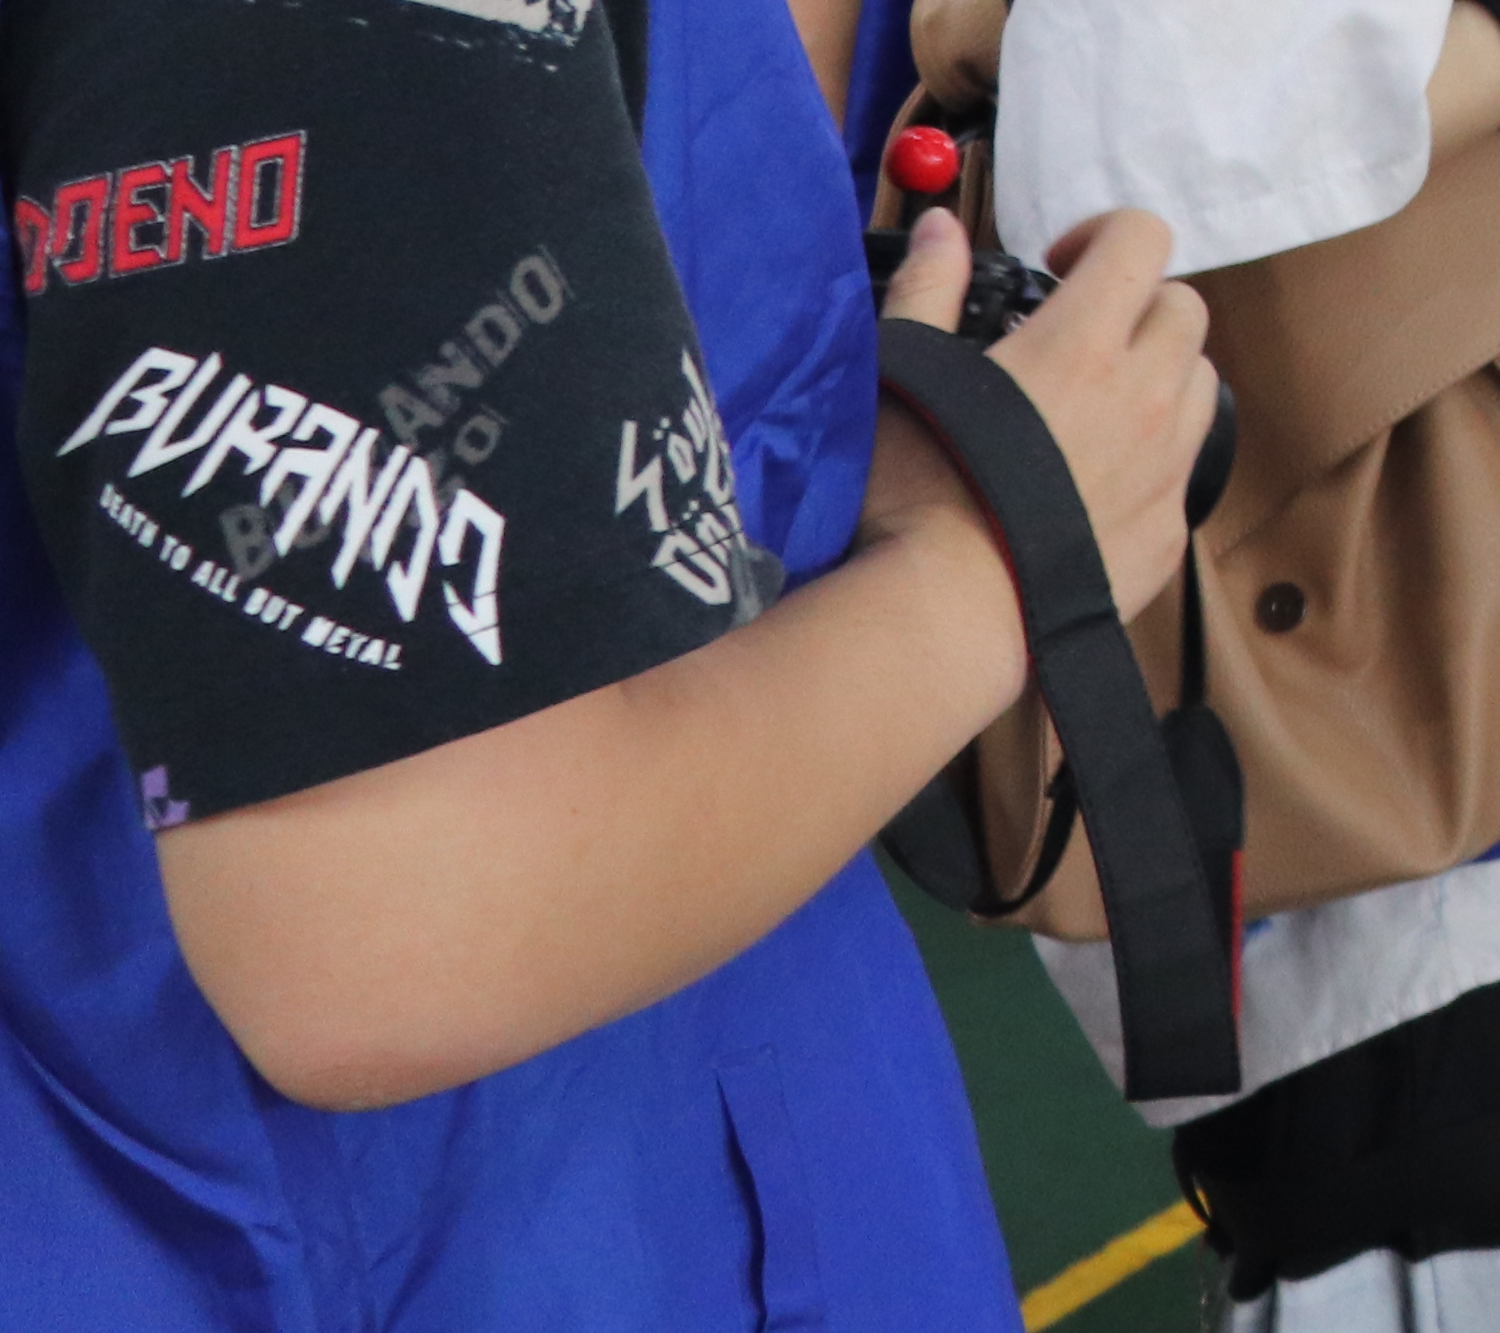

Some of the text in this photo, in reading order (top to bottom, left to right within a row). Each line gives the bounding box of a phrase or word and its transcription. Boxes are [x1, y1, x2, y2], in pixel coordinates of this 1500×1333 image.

[100, 483, 402, 671] DEATH TO ALL BUT METAL
